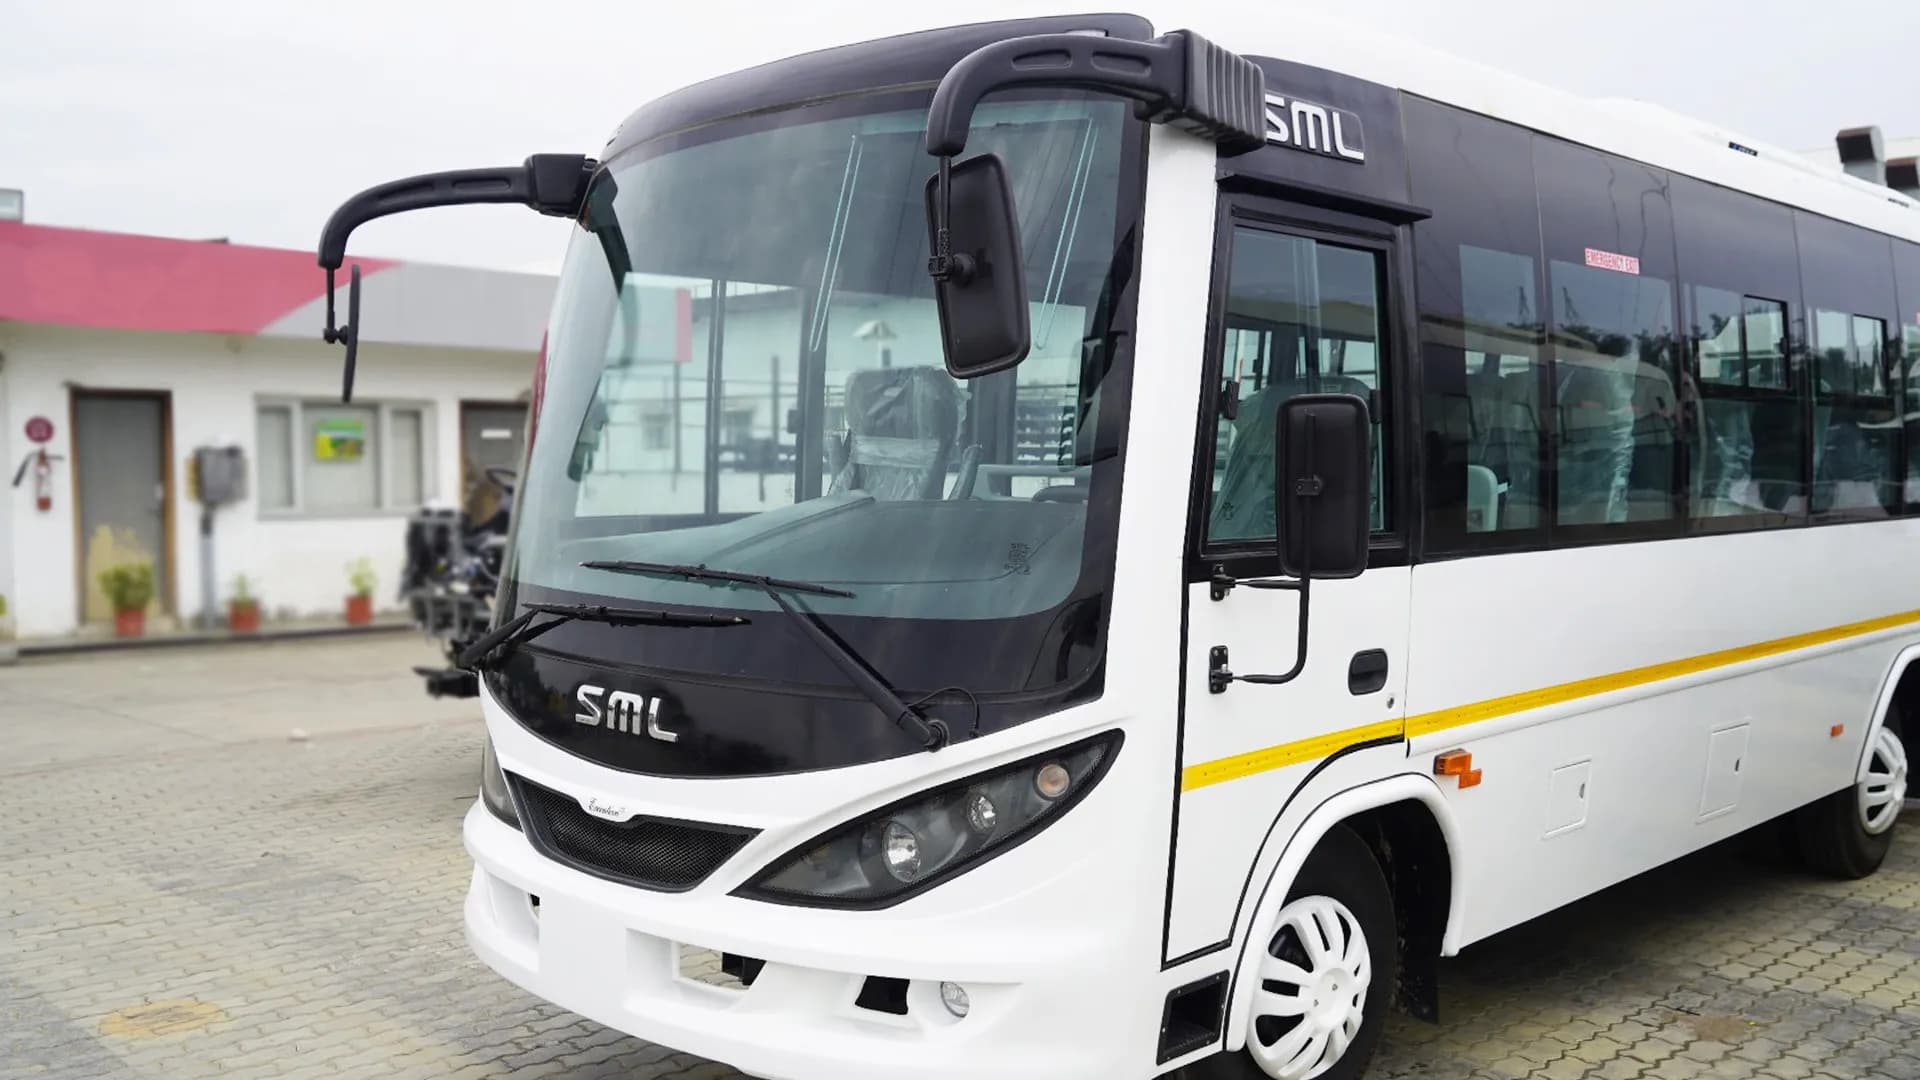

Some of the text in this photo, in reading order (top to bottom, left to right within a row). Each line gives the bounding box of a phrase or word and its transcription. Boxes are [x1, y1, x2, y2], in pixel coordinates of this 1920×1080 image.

[1265, 93, 1365, 161] SML
[1586, 250, 1638, 273] EMERGENCY EXIT
[575, 684, 679, 743] SML
